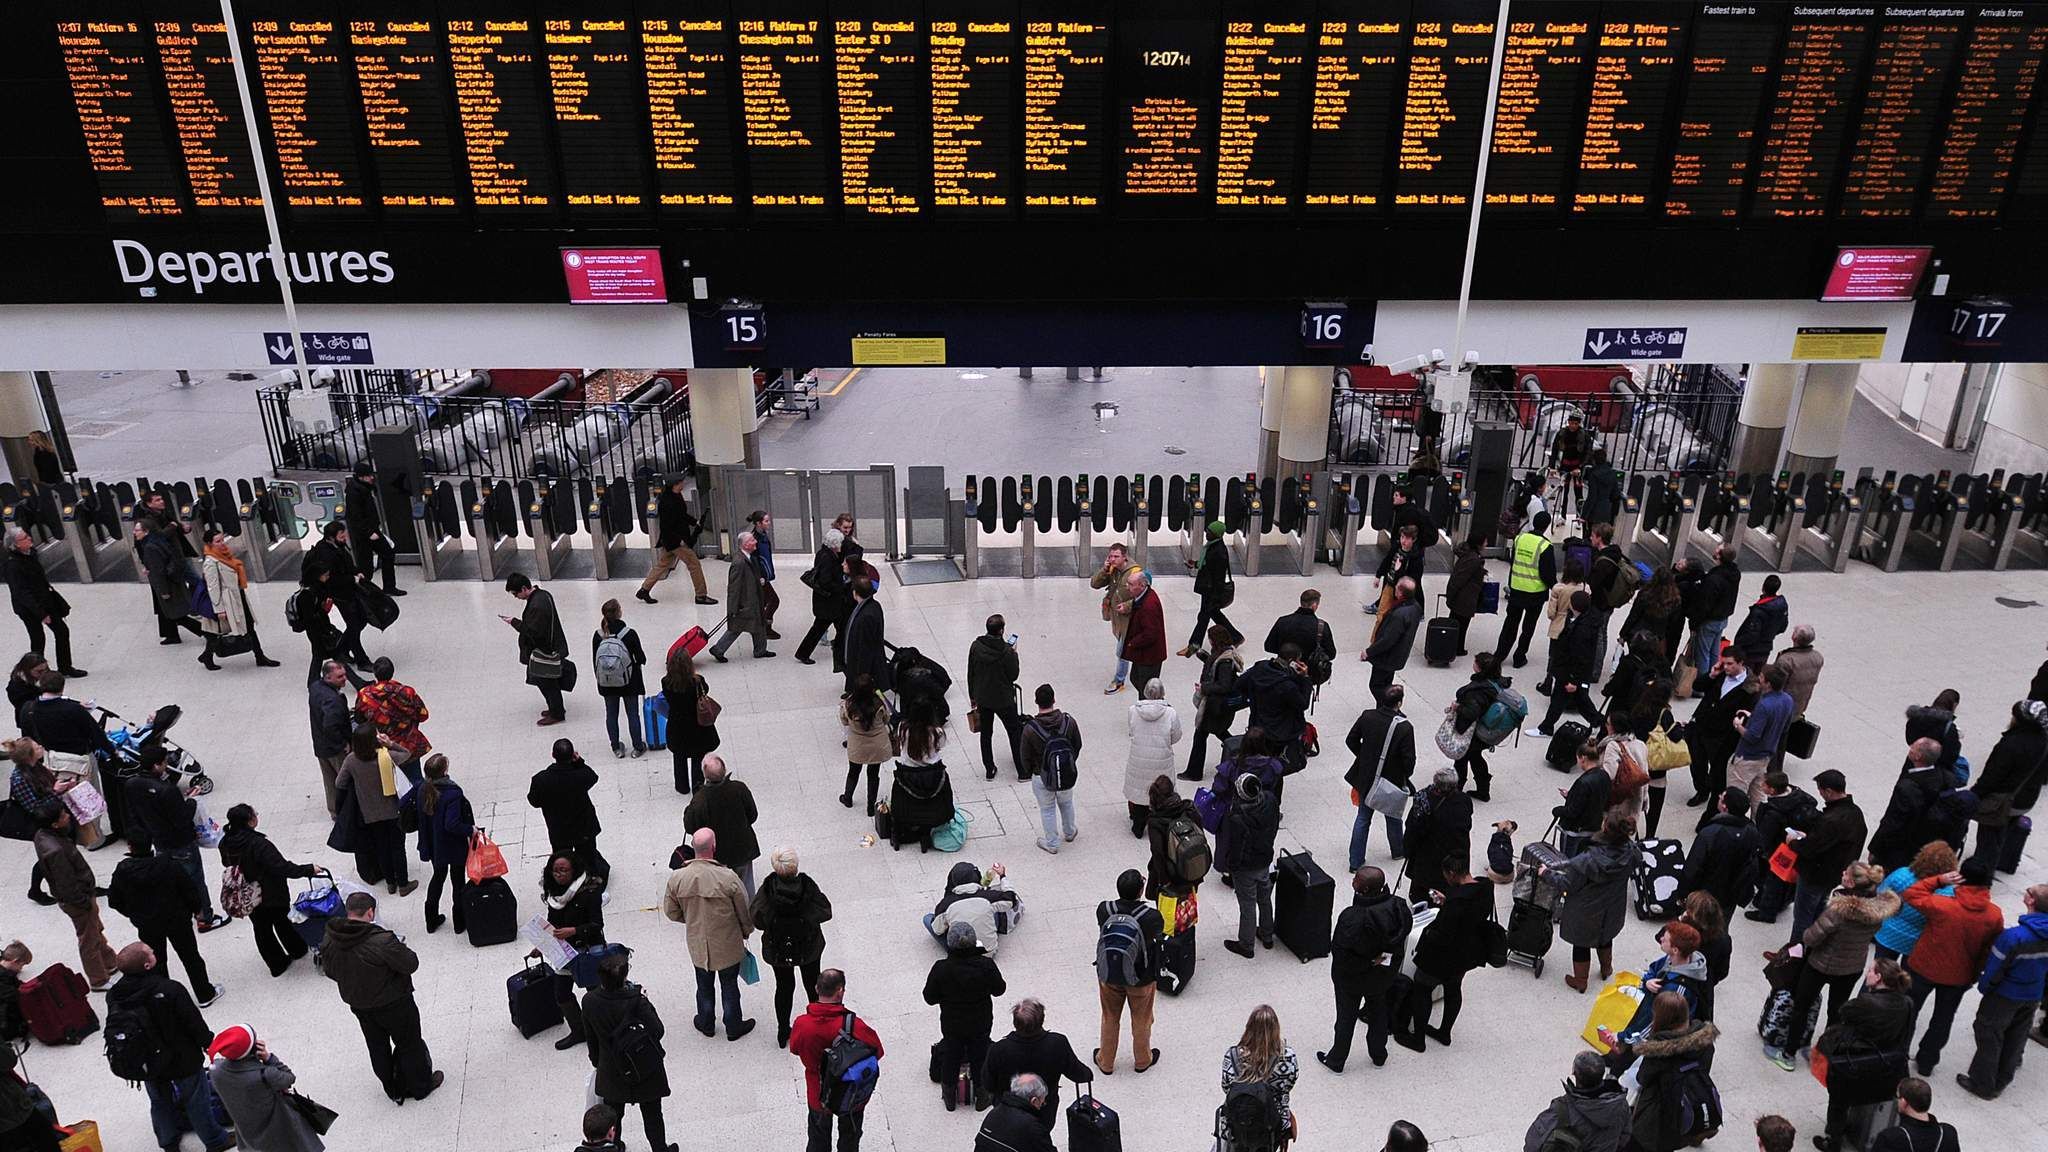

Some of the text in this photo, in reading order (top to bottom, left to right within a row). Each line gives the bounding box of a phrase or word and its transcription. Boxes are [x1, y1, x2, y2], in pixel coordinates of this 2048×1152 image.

[1704, 6, 1730, 14] Fastest
[1794, 7, 1836, 15] Subsequent
[1885, 8, 1927, 16] Subsequent
[2007, 9, 2023, 17] from
[57, 23, 137, 32] 12:07 Platform 16
[155, 23, 180, 32] 12:09
[253, 22, 332, 31] 12:09 Cancelled
[350, 22, 430, 31] 12:12 Cancelled
[448, 21, 528, 31] 12:12 Cancelled
[545, 20, 625, 30] 12:15 Cancelled
[642, 21, 722, 30] 12:15 Cancelled
[739, 21, 818, 31] 12:16 Platform 17
[836, 22, 914, 31] 12:20 Cancelled
[932, 22, 1010, 32] 12:20 Cancelled
[1027, 23, 1093, 32] 12:20 Platform
[1228, 23, 1305, 33] 12:22 Cancelled
[1323, 23, 1399, 33] 12:23 Cancelled
[1417, 23, 1493, 33] 12:24 Cancelled
[1511, 23, 1587, 33] 12:27 Cancelled
[1605, 24, 1668, 33] 12:28 Platform
[59, 36, 100, 45] Hounslow
[157, 36, 198, 45] Guildford
[253, 35, 307, 44] Portsmouth
[351, 35, 407, 45] Basingstoke
[448, 34, 502, 45] Shepperton
[546, 34, 592, 43] Haslemere
[642, 34, 683, 43] Hounslow
[739, 35, 813, 45] Chessington Sth
[835, 34, 866, 44] Exeter
[870, 35, 881, 44] St
[931, 36, 965, 46] Reading
[1026, 36, 1066, 45] Guildford
[1226, 36, 1274, 45] Addlestone
[1320, 36, 1343, 45] Alton
[1414, 36, 1447, 47] Dorking
[1508, 36, 1574, 45] Strawberry Hill
[1600, 36, 1633, 46] Windsor
[1646, 37, 1667, 46] Eton
[1144, 52, 1179, 66] 12:07
[102, 197, 176, 206] South West Trains
[195, 197, 219, 205] South
[221, 197, 241, 205] West
[289, 196, 362, 205] South West Trains
[383, 196, 455, 205] South West Trains
[475, 196, 547, 204] South West Trains
[568, 195, 640, 204] South West Trains
[660, 195, 733, 204] South West Trains
[752, 195, 824, 204] South West Trains
[844, 195, 915, 204] South West Trains
[935, 196, 1006, 205] South West Trains
[1026, 196, 1096, 205] South West Trains
[1216, 195, 1286, 204] South West Trains
[1306, 195, 1376, 204] South West Trains
[1395, 195, 1465, 204] South West Trains
[1486, 194, 1555, 203] South West Trains
[1575, 194, 1644, 203] South West Trains
[1952, 308, 1971, 334] 17
[1977, 313, 2006, 337] 17
[727, 317, 757, 342] 15
[1312, 314, 1342, 340] 16
[1632, 348, 1662, 358] Wide gate
[336, 354, 351, 363] gate
